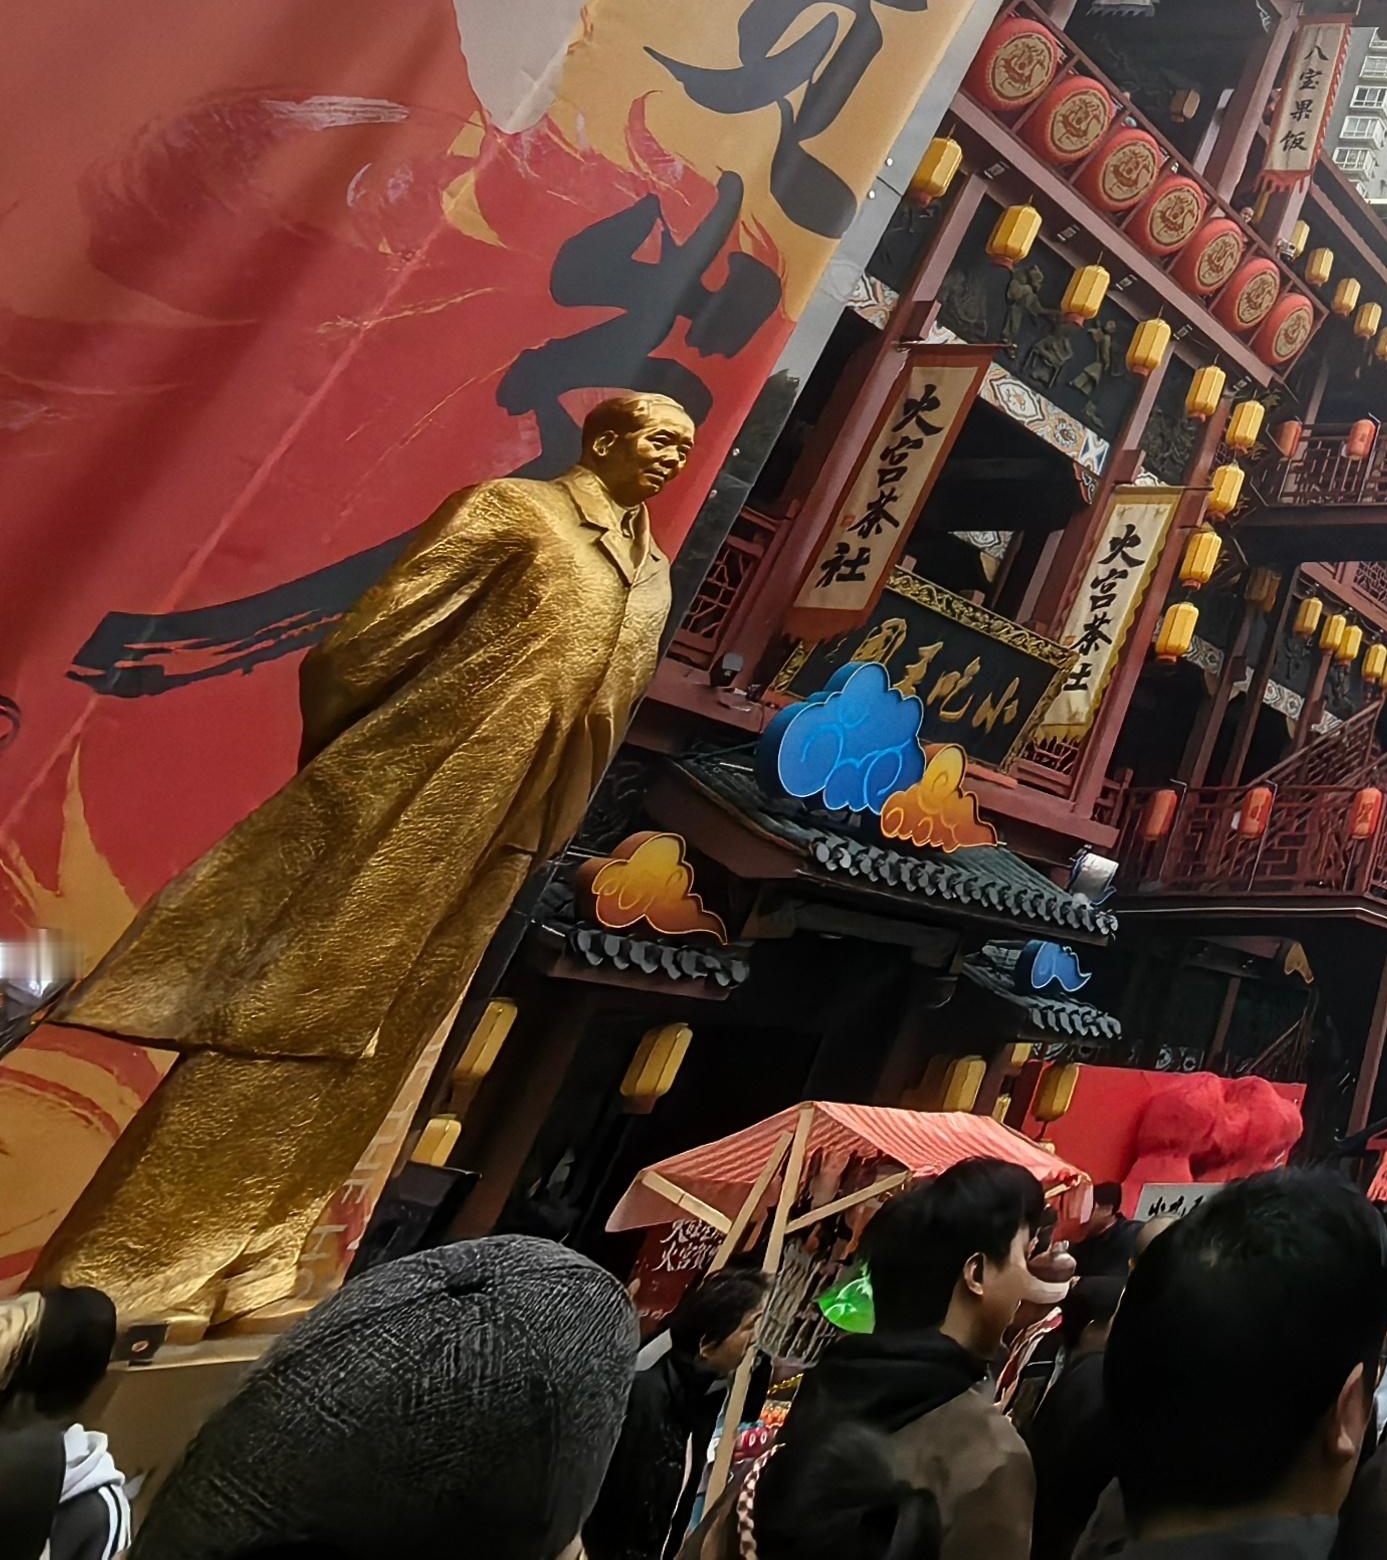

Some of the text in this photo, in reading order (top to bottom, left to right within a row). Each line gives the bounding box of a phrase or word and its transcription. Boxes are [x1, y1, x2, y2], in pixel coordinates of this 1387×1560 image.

[1280, 45, 1329, 152] 八宝果饭
[815, 383, 945, 588] 火宫茶社
